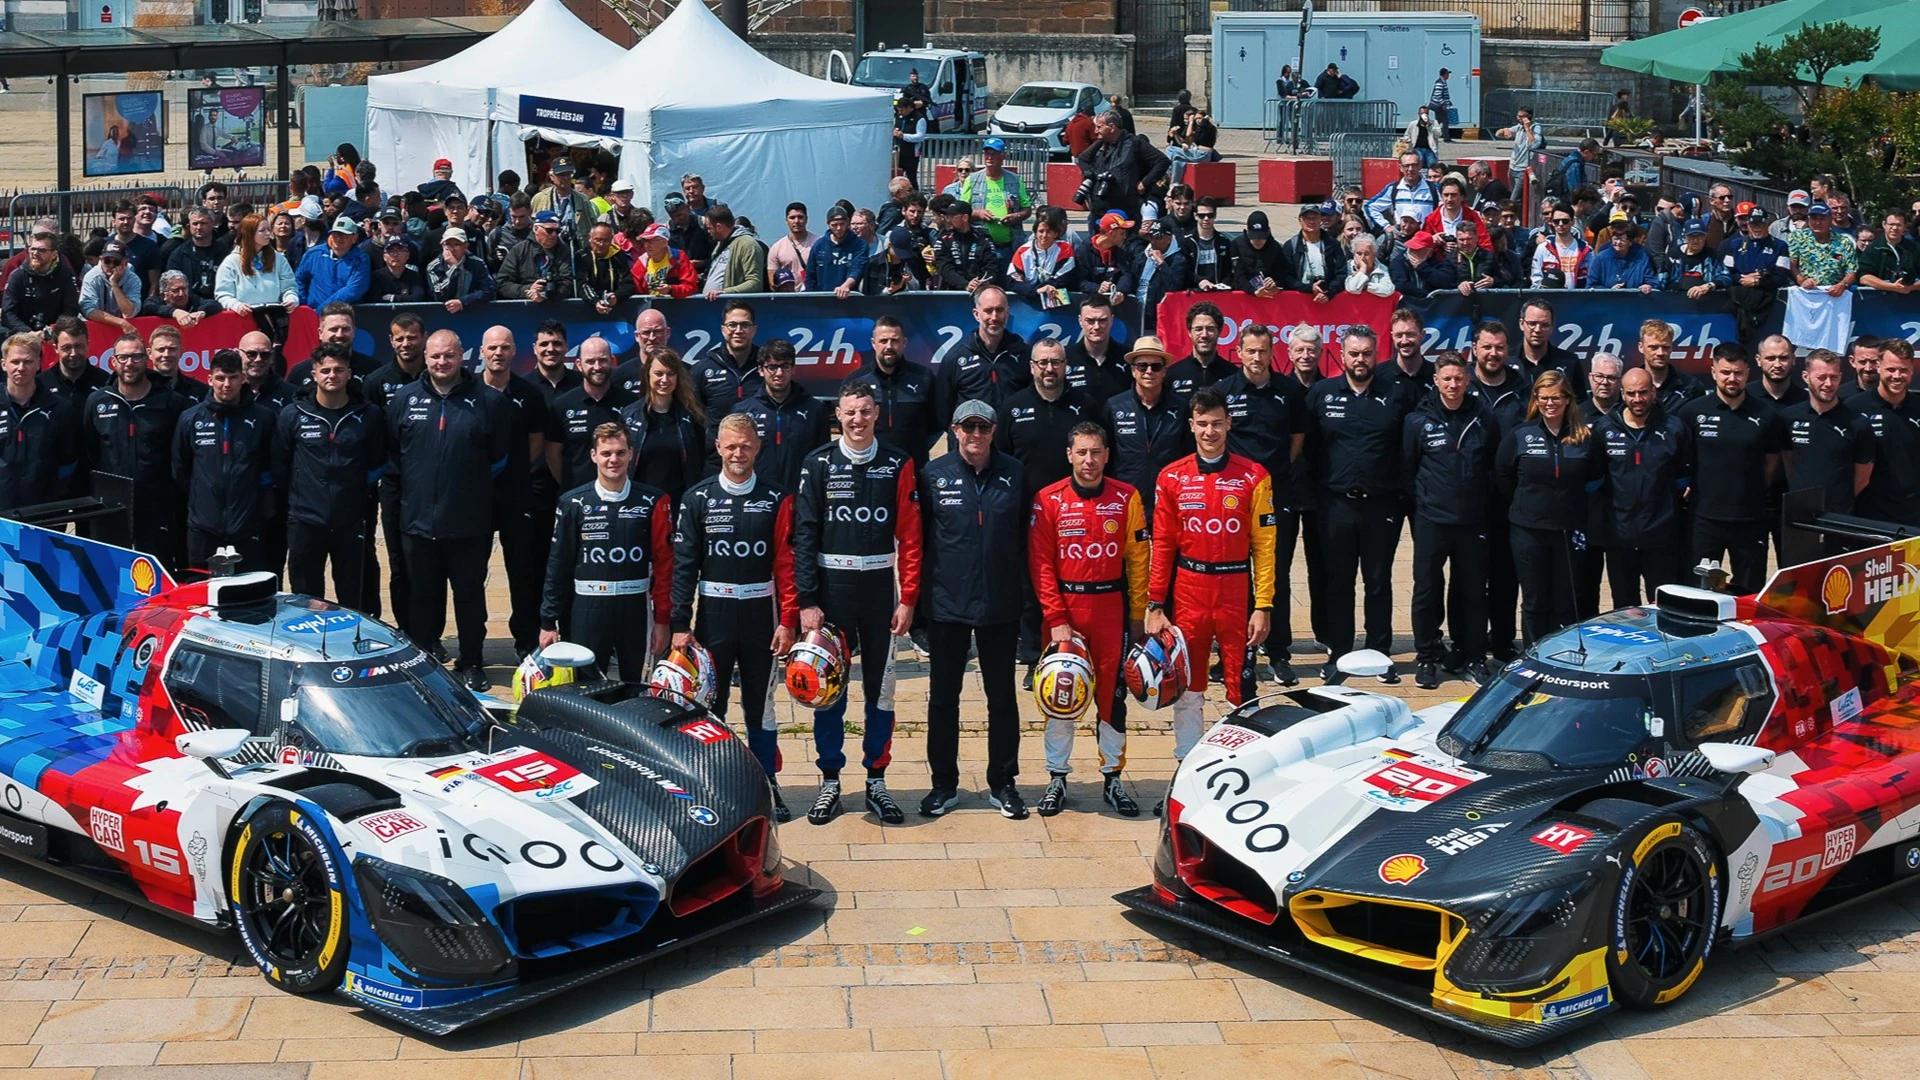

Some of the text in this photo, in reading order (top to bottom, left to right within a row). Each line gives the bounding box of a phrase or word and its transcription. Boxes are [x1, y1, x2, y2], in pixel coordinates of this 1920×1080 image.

[1378, 25, 1410, 33] Toilettes
[536, 107, 584, 123] TROPHÉE DES 24H
[788, 327, 855, 365] 24h
[1556, 323, 1622, 360] 24h
[867, 466, 896, 474] WEC
[1215, 477, 1245, 487] WEC
[618, 506, 649, 514] WEC
[743, 500, 774, 509] WEC
[828, 505, 888, 522] iQOO
[1096, 503, 1125, 511] WEC
[1182, 516, 1241, 534] iQOO
[583, 546, 643, 563] iQOO
[708, 540, 767, 557] iQOO
[1060, 542, 1118, 559] iQOO
[1865, 555, 1892, 578] Shell
[287, 613, 356, 634] MINTH
[77, 677, 98, 694] WEC
[1536, 673, 1610, 691] Motorsport
[685, 722, 724, 740] HY
[1207, 733, 1244, 748] CAR
[495, 759, 558, 784] 15
[587, 746, 662, 779] Motorsport
[443, 779, 461, 793] FIA
[536, 780, 573, 797] WEC
[1378, 766, 1458, 795] 20
[1196, 754, 1289, 853] iQOO
[91, 808, 120, 830] HYPER
[364, 813, 406, 828] HYPER
[375, 818, 421, 838] CAR
[93, 825, 123, 851] CAR
[1426, 827, 1468, 847] Shell
[1536, 826, 1587, 847] HY
[1826, 827, 1854, 848] HYPER
[133, 840, 181, 876] 15
[304, 824, 337, 884] MICHELIN
[436, 828, 625, 872] iQOO
[1823, 841, 1853, 866] CAR
[1763, 854, 1822, 893] 20
[1616, 867, 1634, 939] MICHELIN
[364, 985, 415, 1004] MICHELIN
[1559, 993, 1604, 1015] MICHELIN
